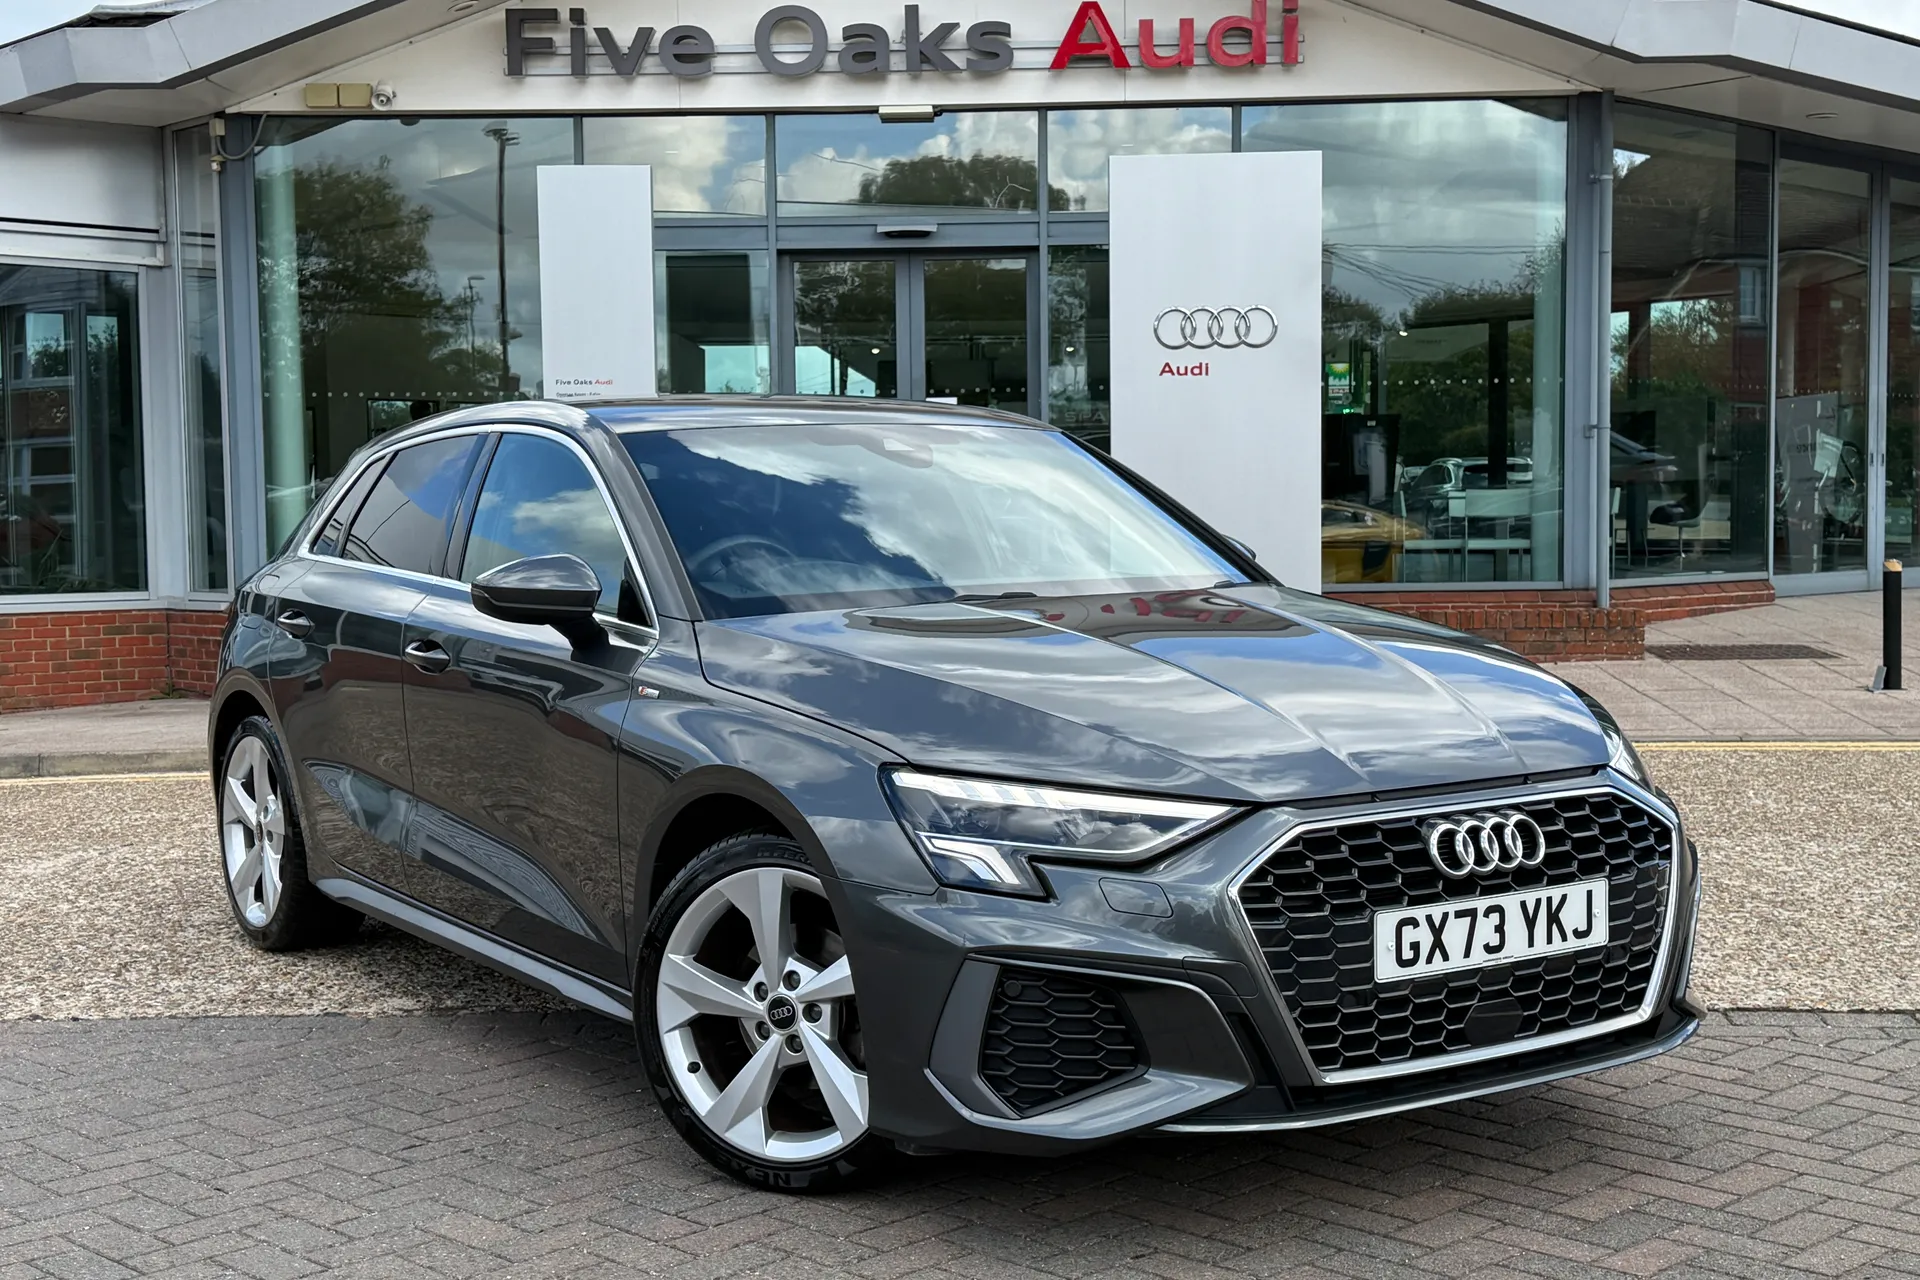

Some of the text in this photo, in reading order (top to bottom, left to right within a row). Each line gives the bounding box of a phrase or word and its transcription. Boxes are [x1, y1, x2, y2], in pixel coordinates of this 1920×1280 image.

[505, 0, 1299, 78] Five Oaks Audi
[1159, 362, 1210, 377] Audi
[1395, 889, 1593, 969] GX73 YKJ
